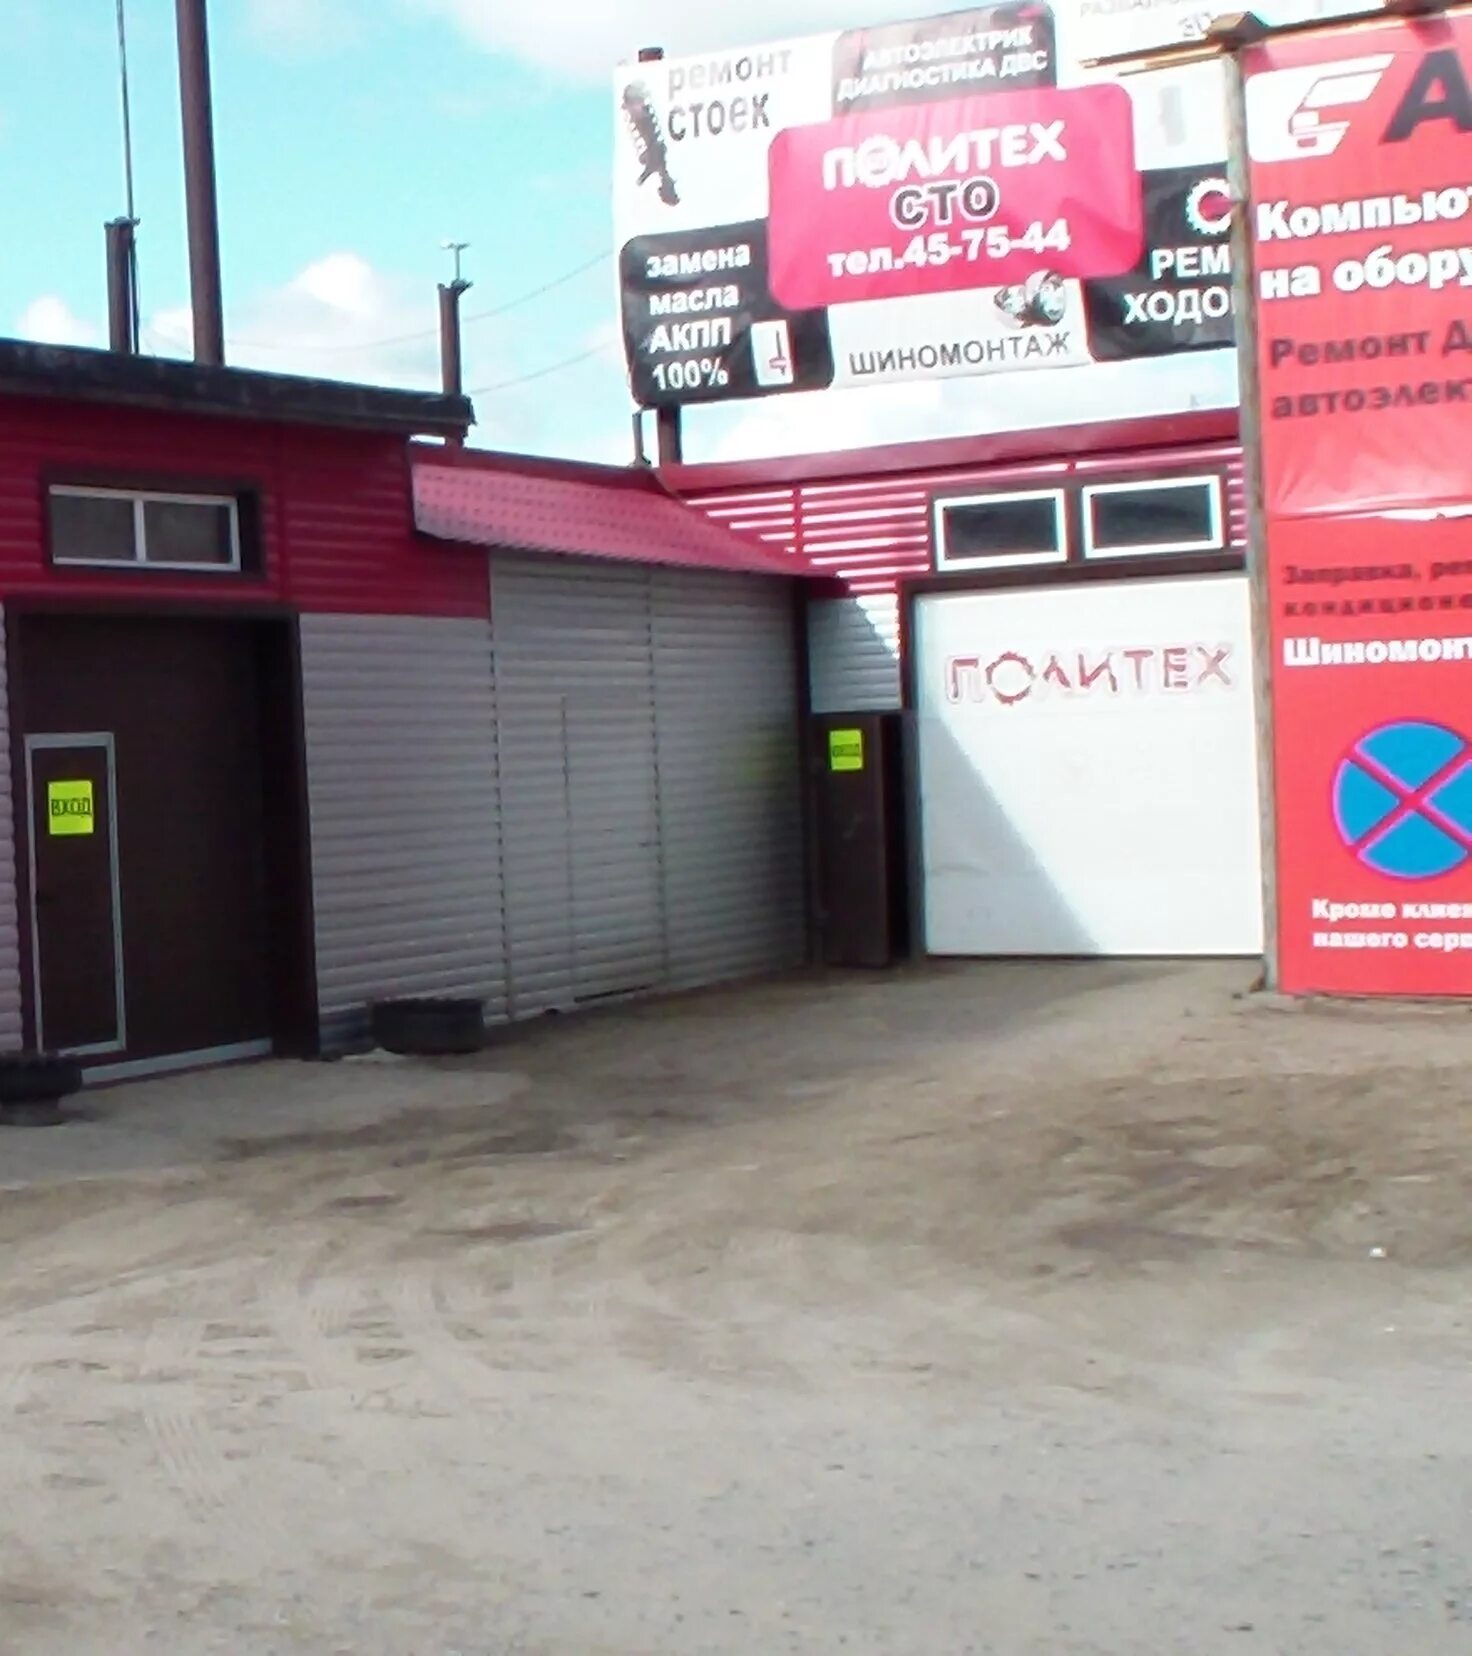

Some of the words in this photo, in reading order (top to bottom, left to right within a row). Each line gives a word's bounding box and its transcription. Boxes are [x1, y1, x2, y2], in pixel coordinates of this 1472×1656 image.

[668, 50, 791, 101] ремонт
[837, 58, 996, 101] ДИАГНОСТИКА
[999, 50, 1047, 78] ДВС
[667, 92, 769, 141] стоек
[823, 119, 1067, 190] ПОЛИТЕХ
[891, 177, 998, 228] СТО
[1256, 186, 1472, 242] Компью
[645, 244, 750, 278] замена
[1152, 245, 1230, 281] РЕМ
[1259, 264, 1321, 299] на
[649, 284, 739, 316] масла
[1122, 284, 1236, 326] ХОДО
[649, 317, 731, 354] АКПП
[849, 331, 1071, 376] ШИНОМОНТАЖ
[1270, 330, 1432, 368] Ремонт
[652, 356, 728, 392] 100%
[946, 643, 1236, 705] ПОЛИТЕХ
[1312, 898, 1397, 922] Кроме
